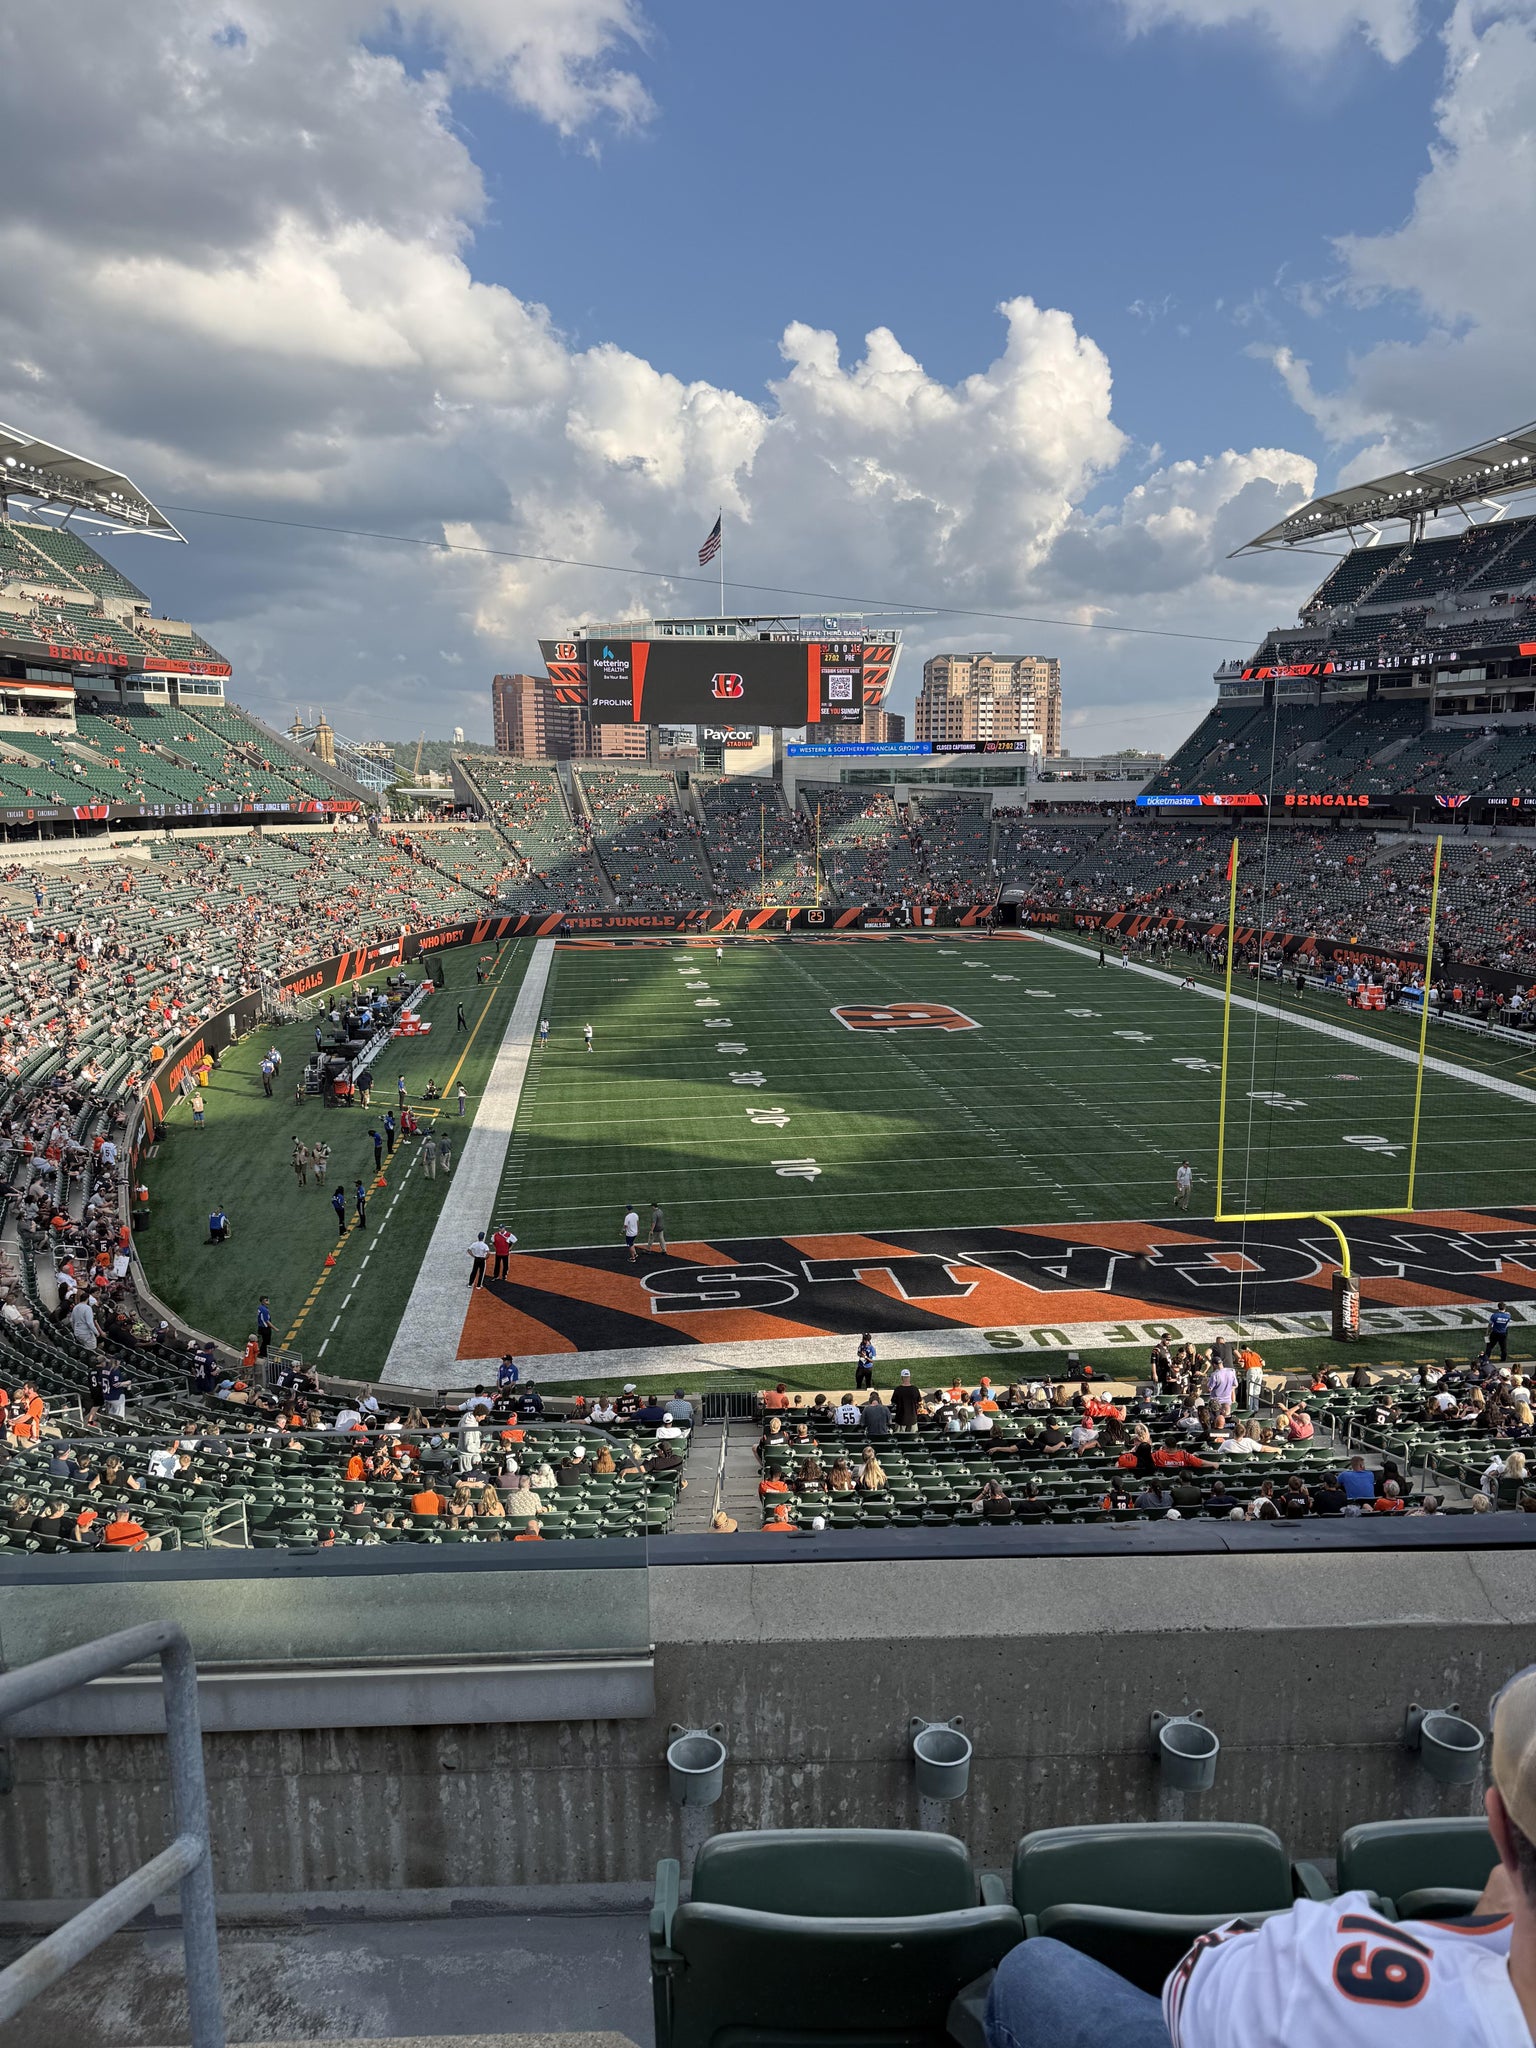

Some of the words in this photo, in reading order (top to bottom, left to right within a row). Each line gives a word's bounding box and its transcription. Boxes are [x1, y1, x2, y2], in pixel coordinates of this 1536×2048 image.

[48, 646, 129, 667] BENGALS
[593, 659, 630, 669] Kettering
[703, 728, 753, 743] Paycor
[264, 803, 280, 811] JUNGLE
[1147, 796, 1194, 805] ticketmaster
[1284, 794, 1370, 806] BENGALS
[565, 917, 603, 928] THE
[605, 916, 675, 927] JUNGLE
[810, 911, 823, 921] 25
[420, 936, 440, 949] WHO
[445, 930, 465, 943] DEY
[745, 1107, 791, 1124] 20
[1342, 1135, 1408, 1152] 10
[770, 1157, 822, 1177] 10
[1102, 1323, 1183, 1343] OF
[1207, 1315, 1330, 1337] ALL
[983, 1328, 1074, 1350] US
[843, 1412, 856, 1425] 55
